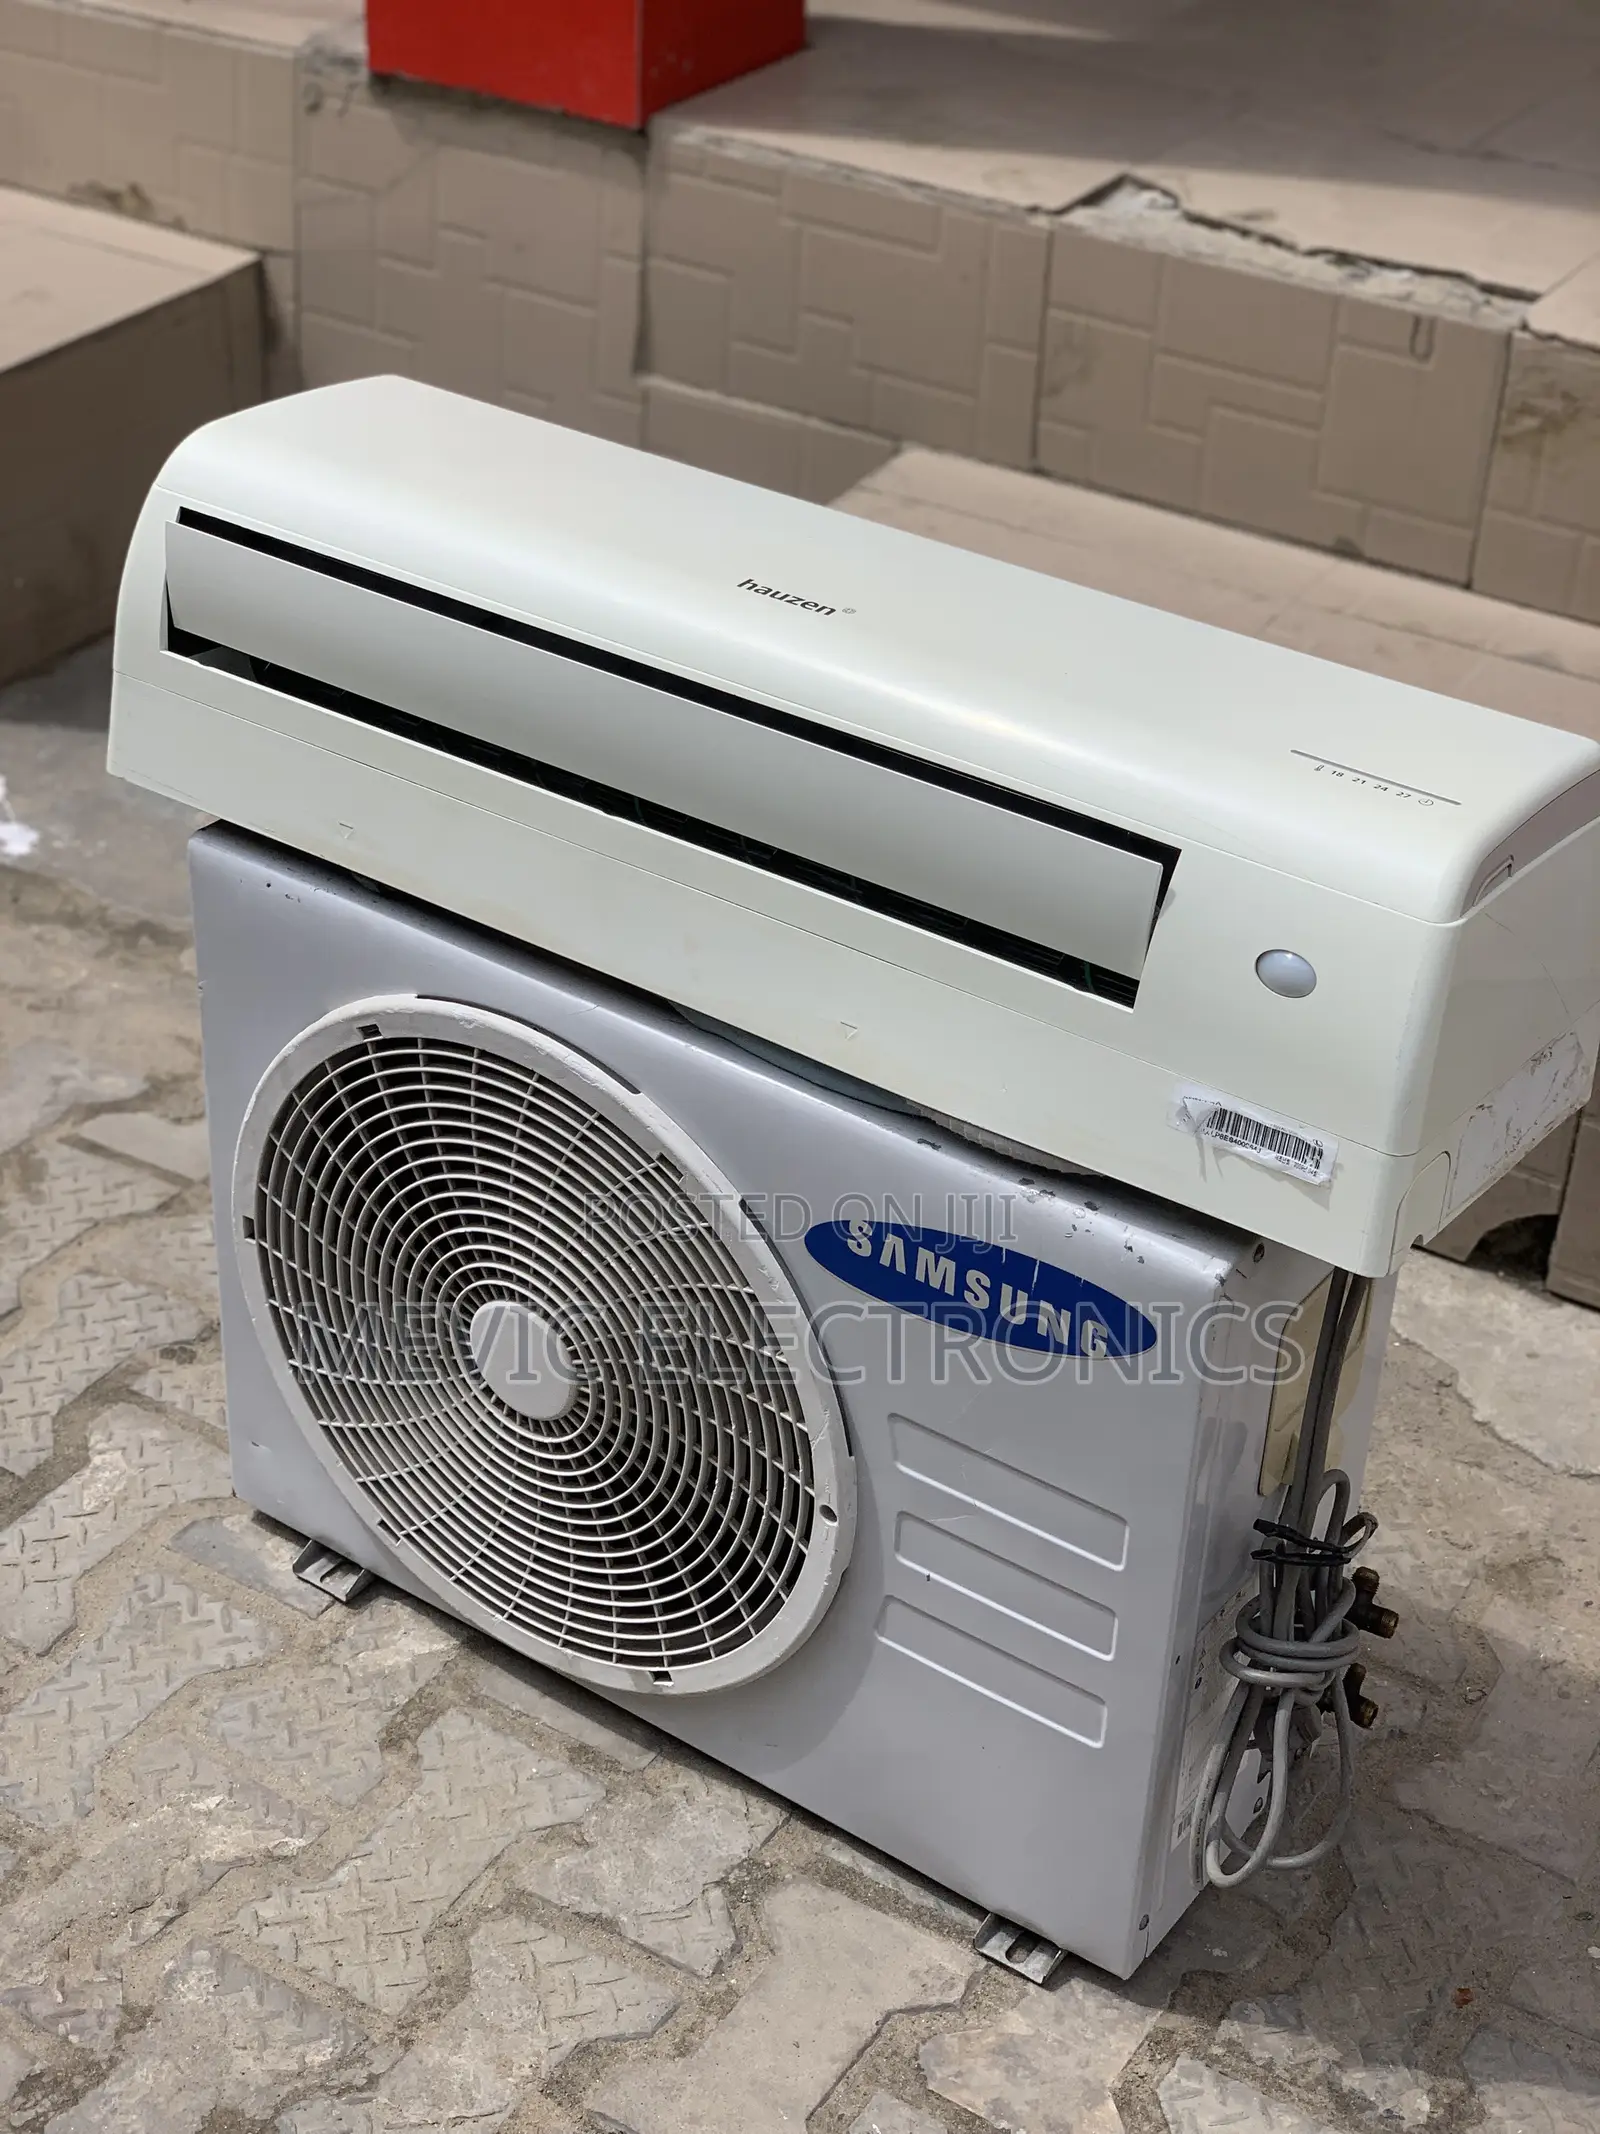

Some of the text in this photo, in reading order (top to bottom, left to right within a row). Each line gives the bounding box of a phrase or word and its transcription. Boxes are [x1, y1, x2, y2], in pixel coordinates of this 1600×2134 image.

[736, 578, 837, 616] hauzen
[1331, 770, 1411, 799] 18 21 24 27
[846, 1219, 1109, 1358] SAMSUNG
